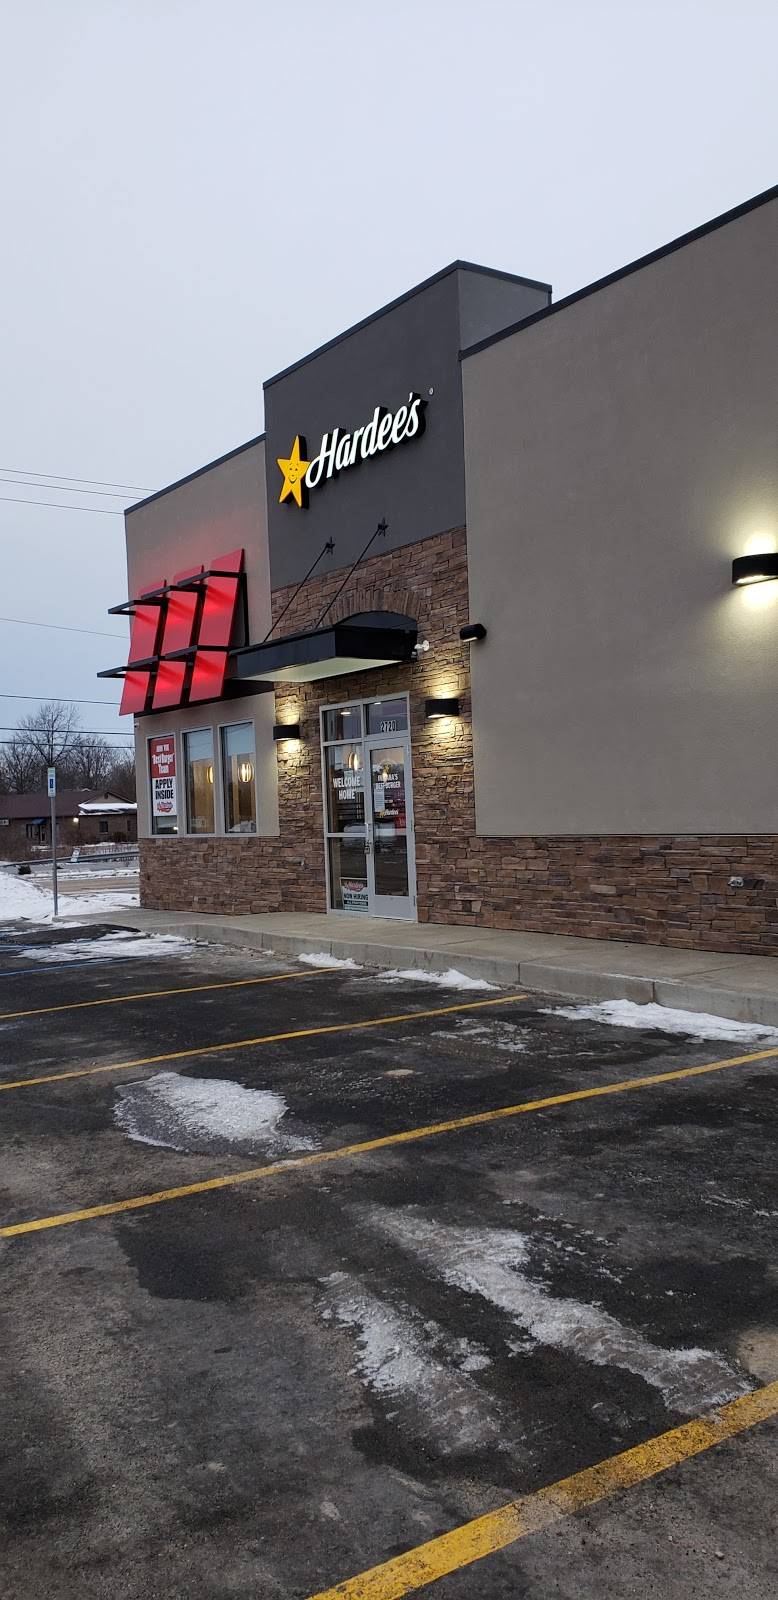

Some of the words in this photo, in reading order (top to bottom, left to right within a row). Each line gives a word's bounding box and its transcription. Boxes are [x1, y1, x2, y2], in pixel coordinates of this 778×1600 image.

[305, 392, 421, 489] Hardee's
[380, 720, 396, 732] 2720
[155, 778, 173, 789] APPLY
[333, 776, 361, 788] WELCOME
[155, 790, 174, 800] INSIDE
[338, 789, 356, 800] HOME
